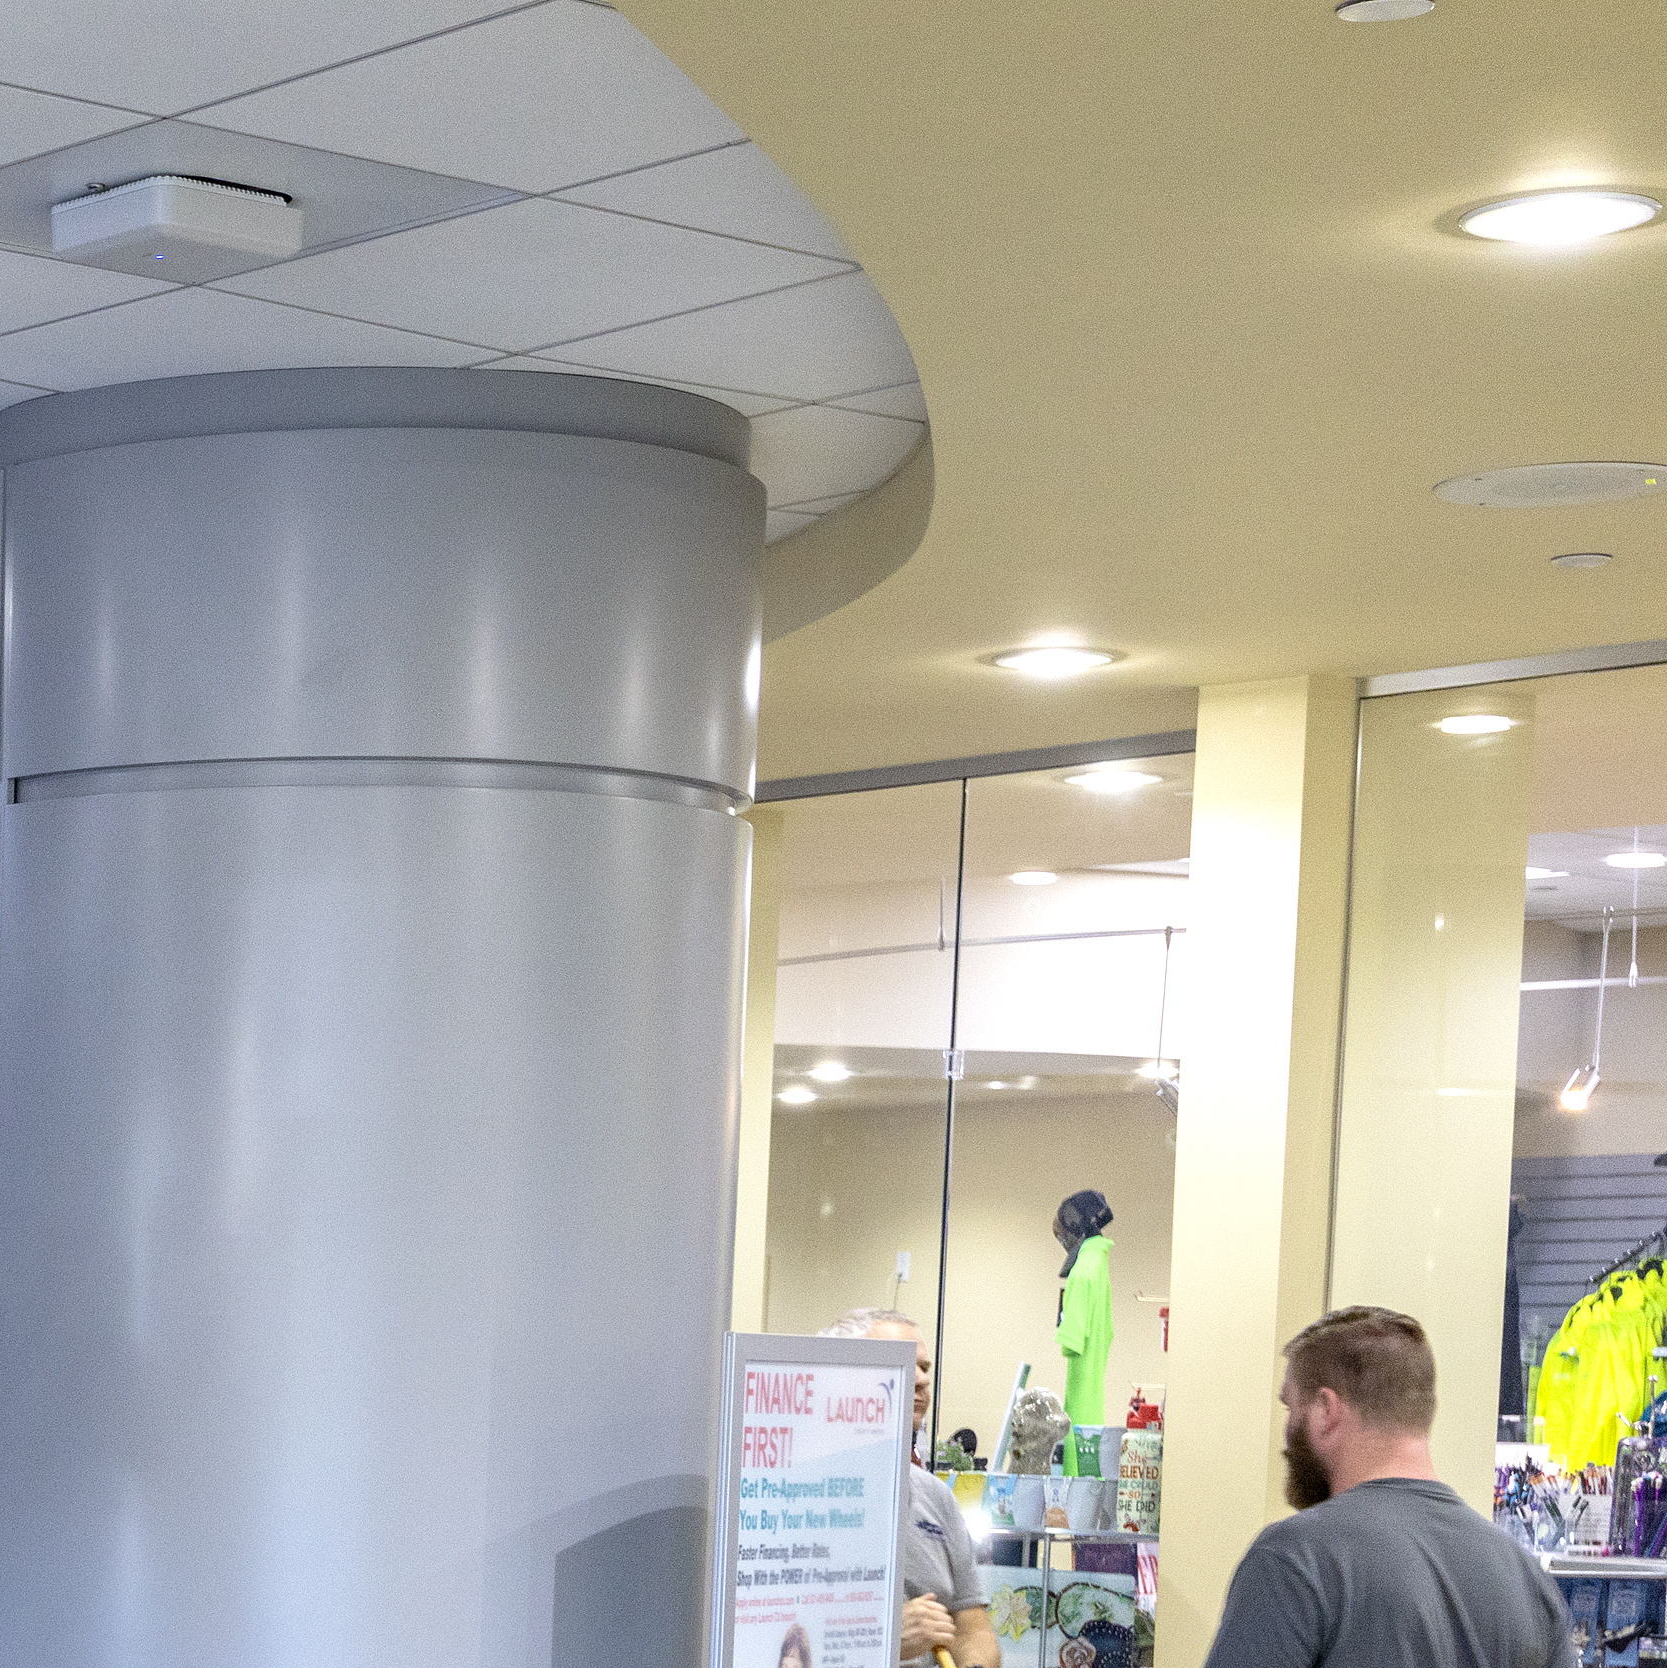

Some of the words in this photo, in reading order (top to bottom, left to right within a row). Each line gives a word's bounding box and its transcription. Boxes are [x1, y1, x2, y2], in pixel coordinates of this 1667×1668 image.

[745, 1371, 814, 1415] FINANCE
[741, 1426, 793, 1468] FIRST!
[741, 1478, 758, 1498] Get
[761, 1478, 825, 1503] Pre-Approved
[740, 1509, 757, 1530] You
[760, 1509, 778, 1534] Buy
[782, 1509, 803, 1529] Your
[805, 1509, 826, 1528] New
